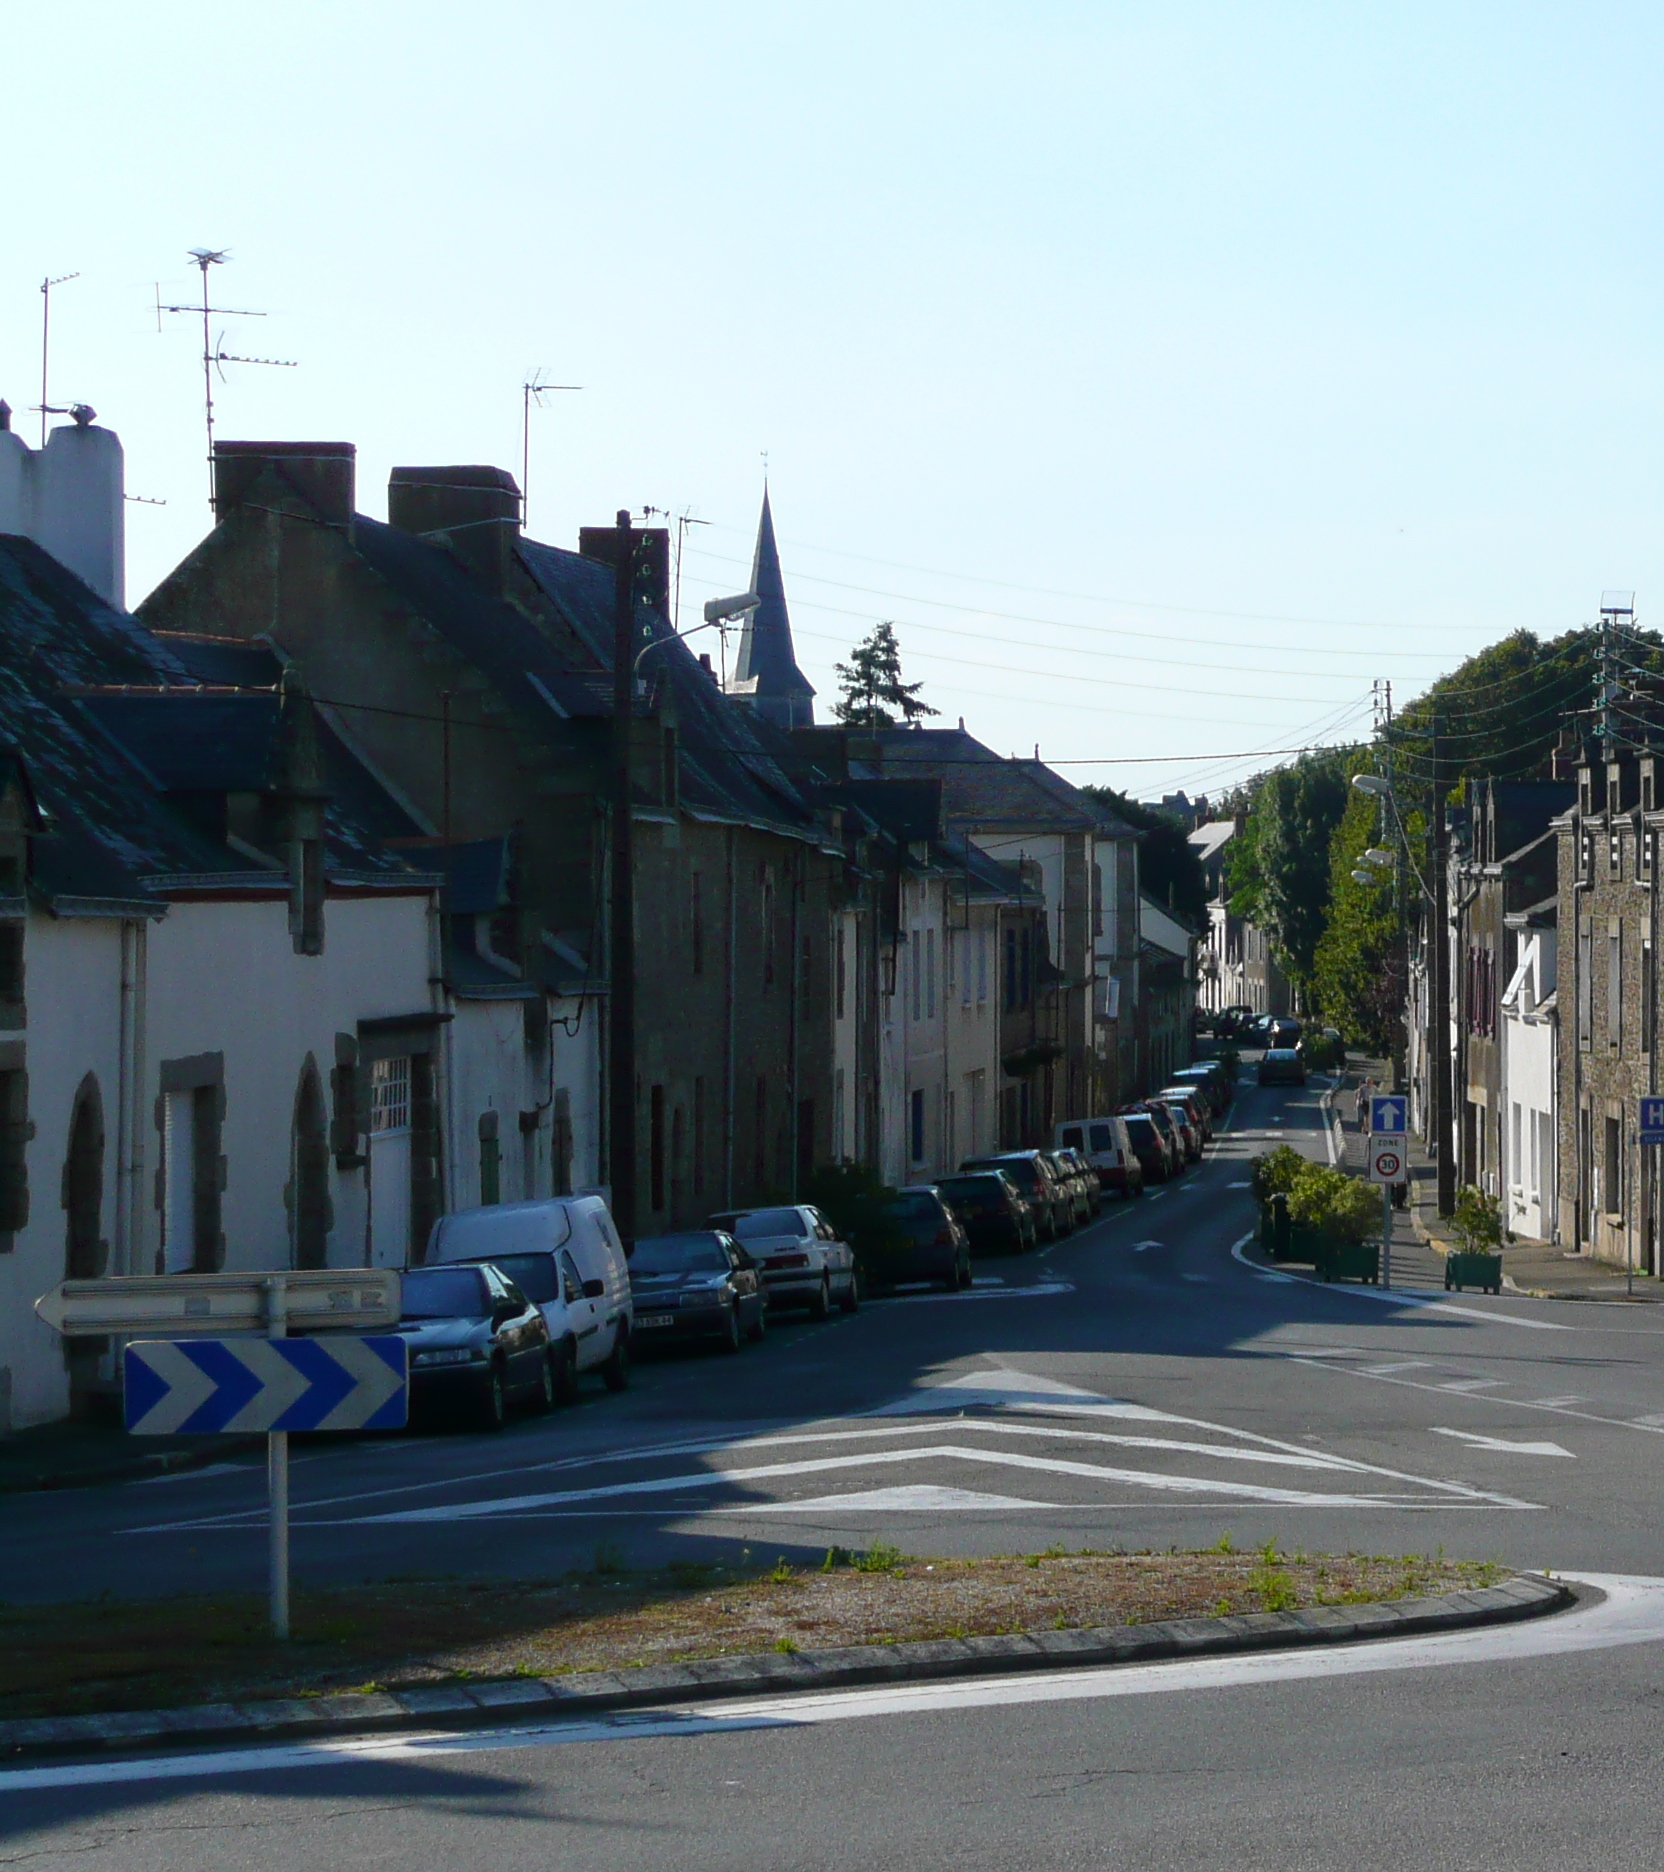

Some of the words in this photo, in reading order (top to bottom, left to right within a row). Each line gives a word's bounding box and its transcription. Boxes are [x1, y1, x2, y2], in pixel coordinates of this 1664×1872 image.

[1649, 1103, 1664, 1125] H
[1378, 1139, 1399, 1147] ZONE
[1381, 1159, 1396, 1169] 30
